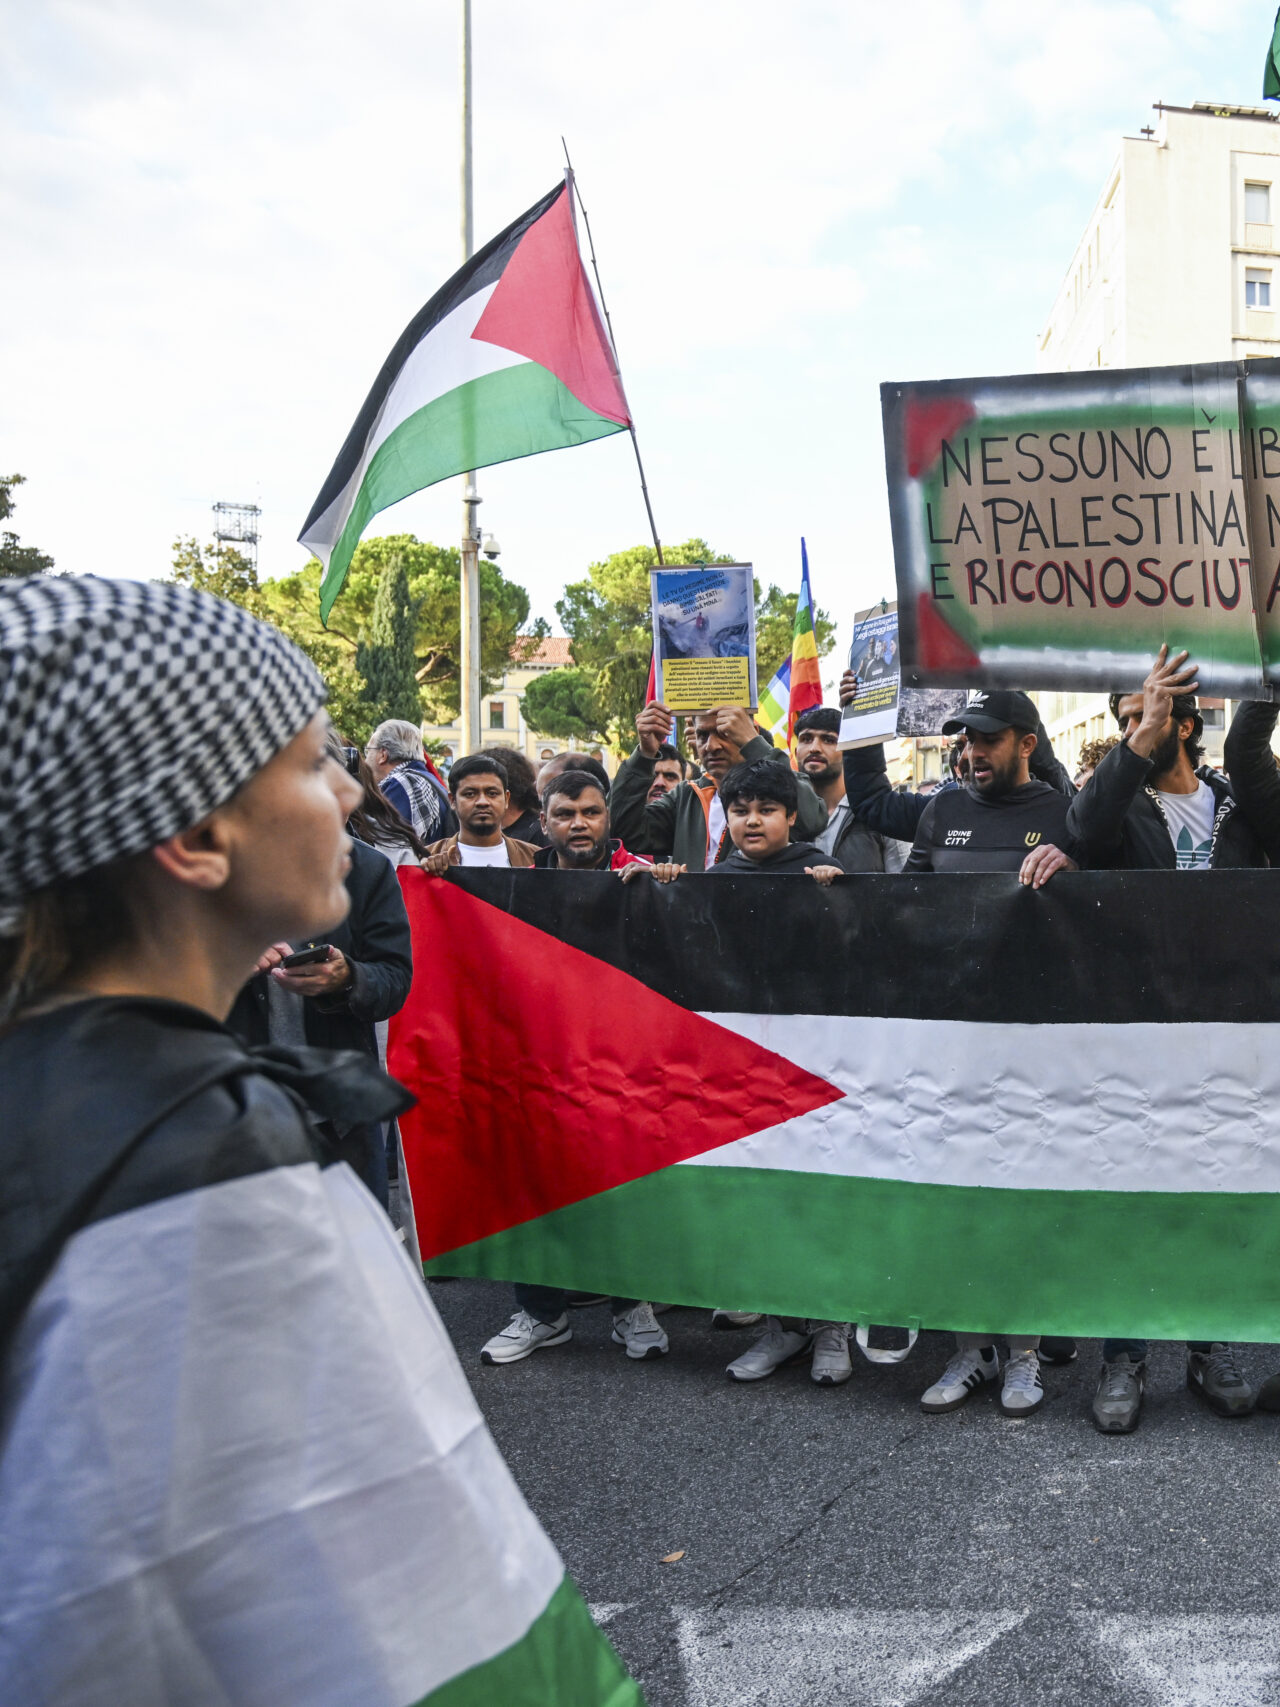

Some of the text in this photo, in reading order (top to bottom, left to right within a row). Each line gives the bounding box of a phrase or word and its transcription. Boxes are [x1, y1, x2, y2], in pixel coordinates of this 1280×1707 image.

[941, 427, 1172, 487] NESSUNO
[927, 502, 982, 545] LA
[981, 489, 1246, 555] PALESTINA
[930, 563, 955, 600] E
[944, 837, 970, 846] CITY
